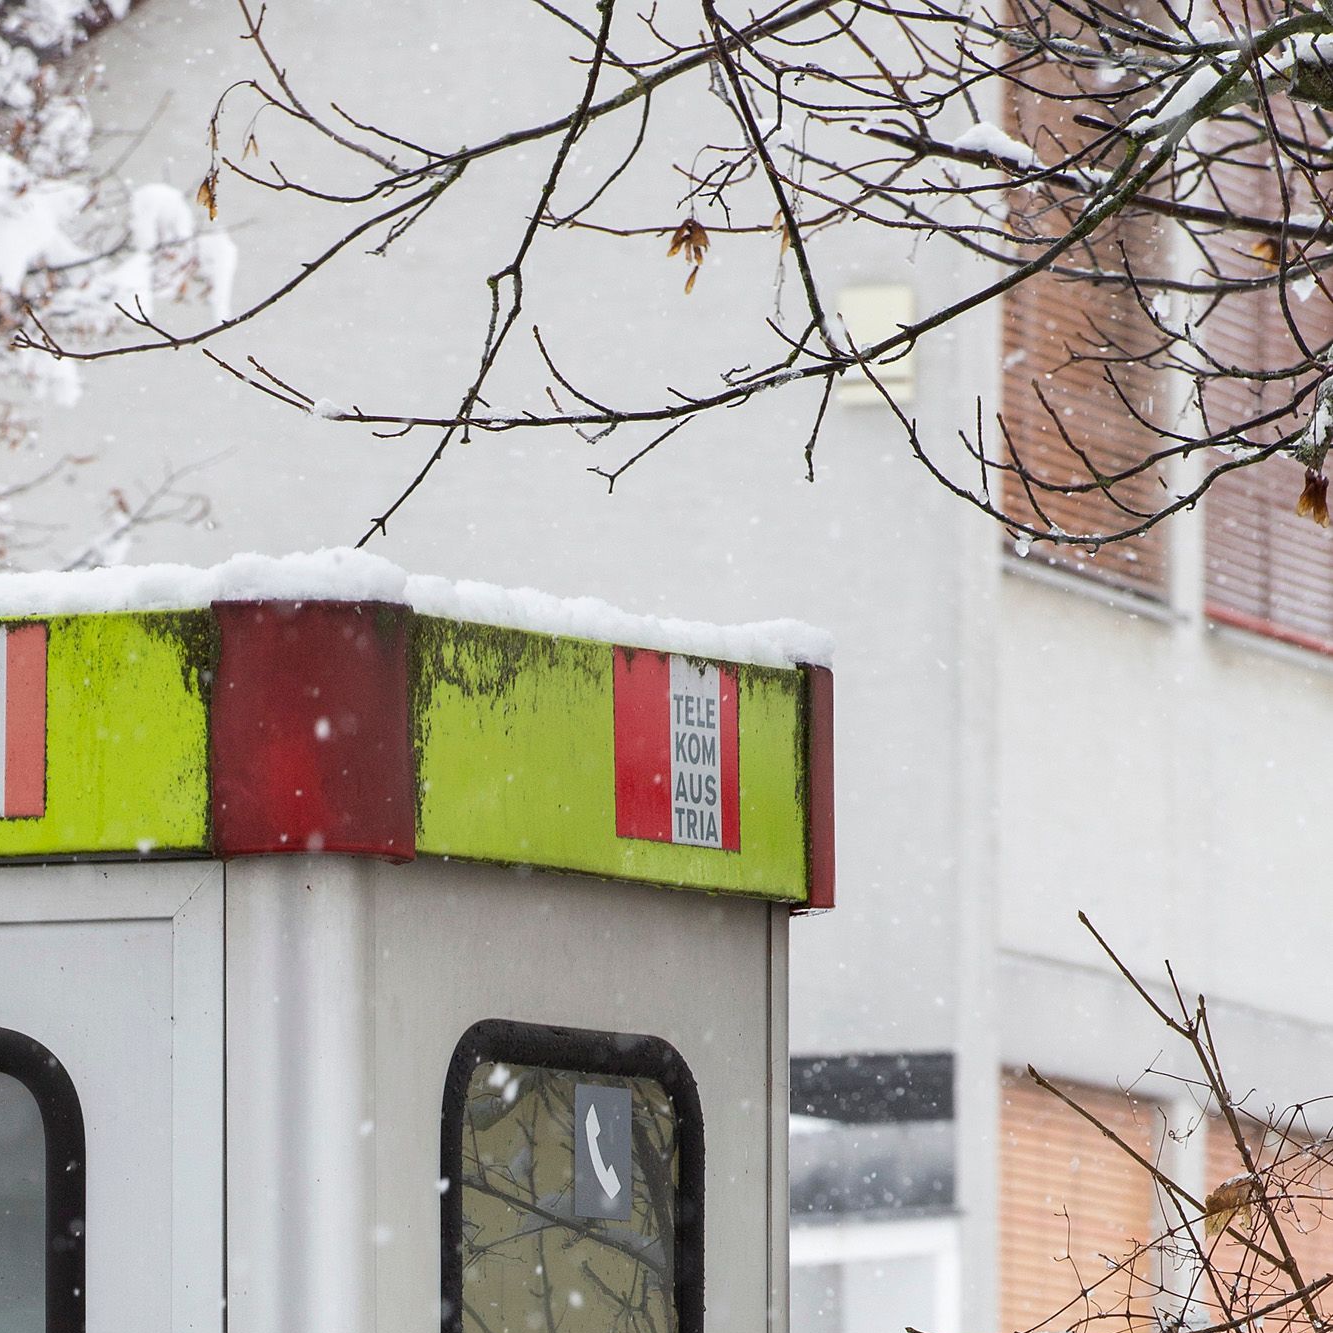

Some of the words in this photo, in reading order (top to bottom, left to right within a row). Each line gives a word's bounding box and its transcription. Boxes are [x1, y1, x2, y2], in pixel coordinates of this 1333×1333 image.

[673, 694, 716, 729] TELE
[675, 731, 716, 766] KOM
[675, 771, 717, 806] AUS
[675, 808, 719, 842] TRIA
